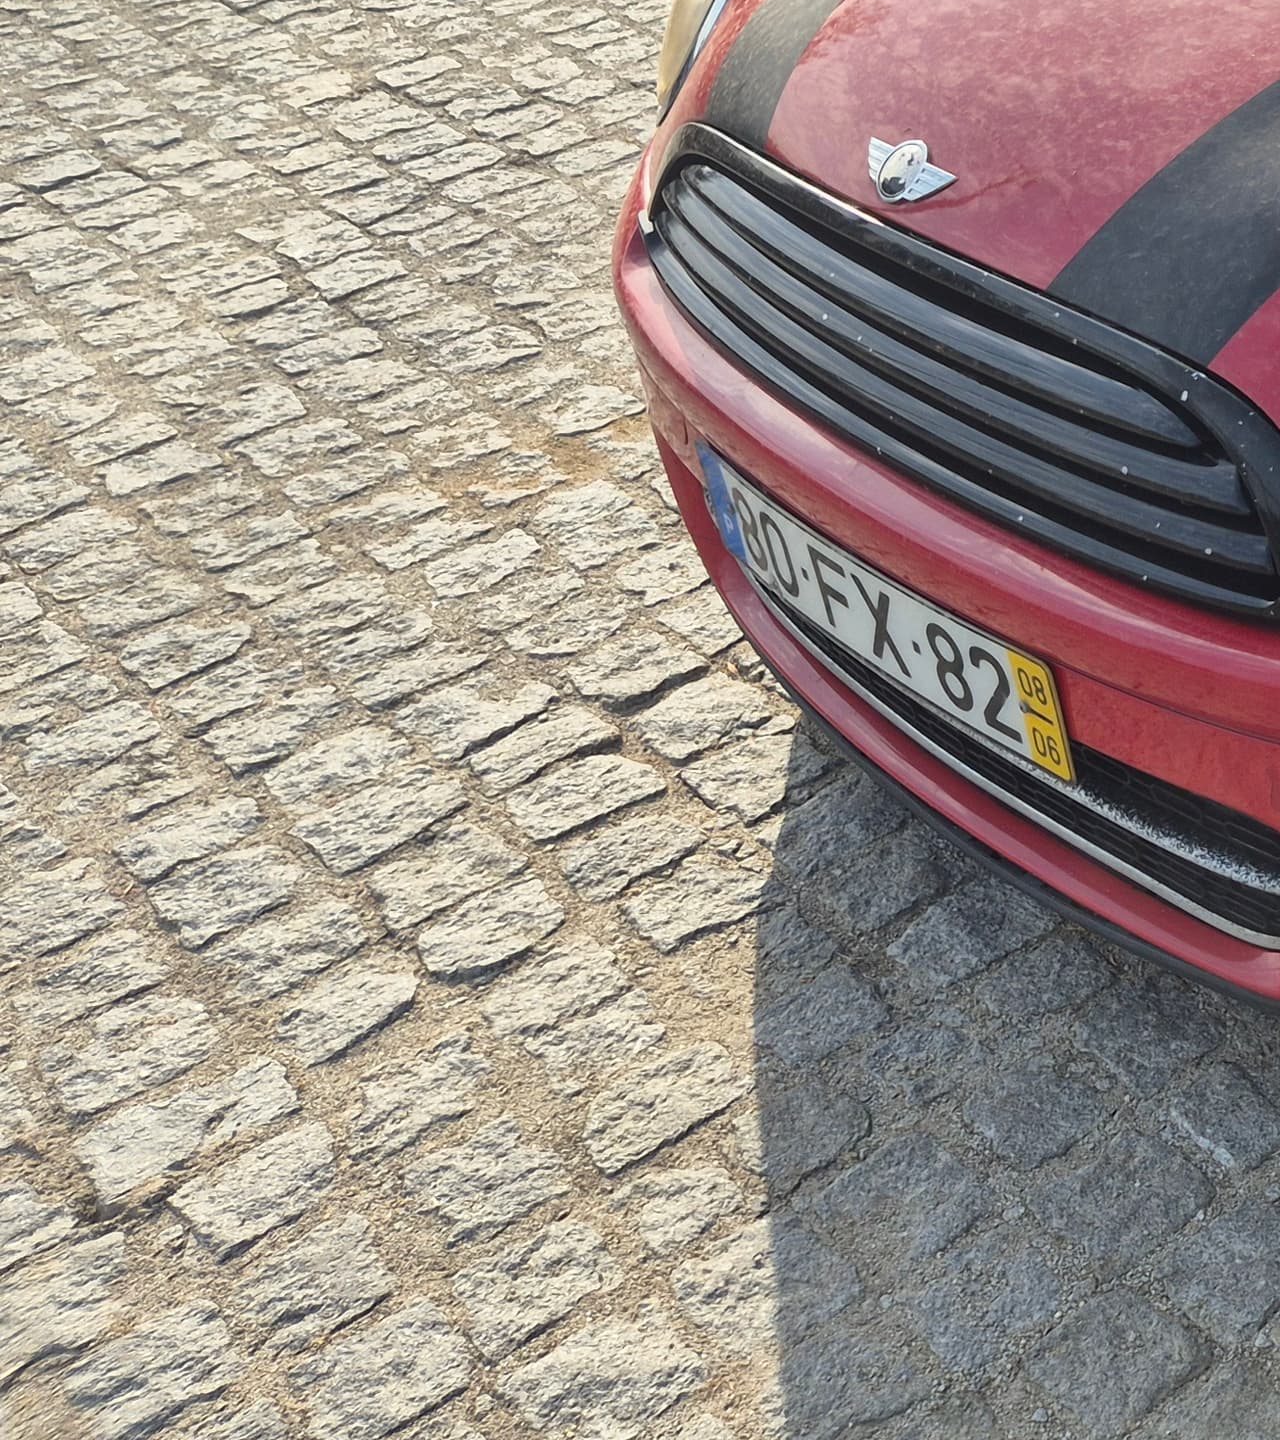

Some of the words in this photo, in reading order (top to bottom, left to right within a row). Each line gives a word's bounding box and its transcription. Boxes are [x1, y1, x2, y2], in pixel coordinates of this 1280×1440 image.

[723, 513, 735, 534] P
[1017, 667, 1048, 706] 08
[1032, 726, 1061, 766] 06
